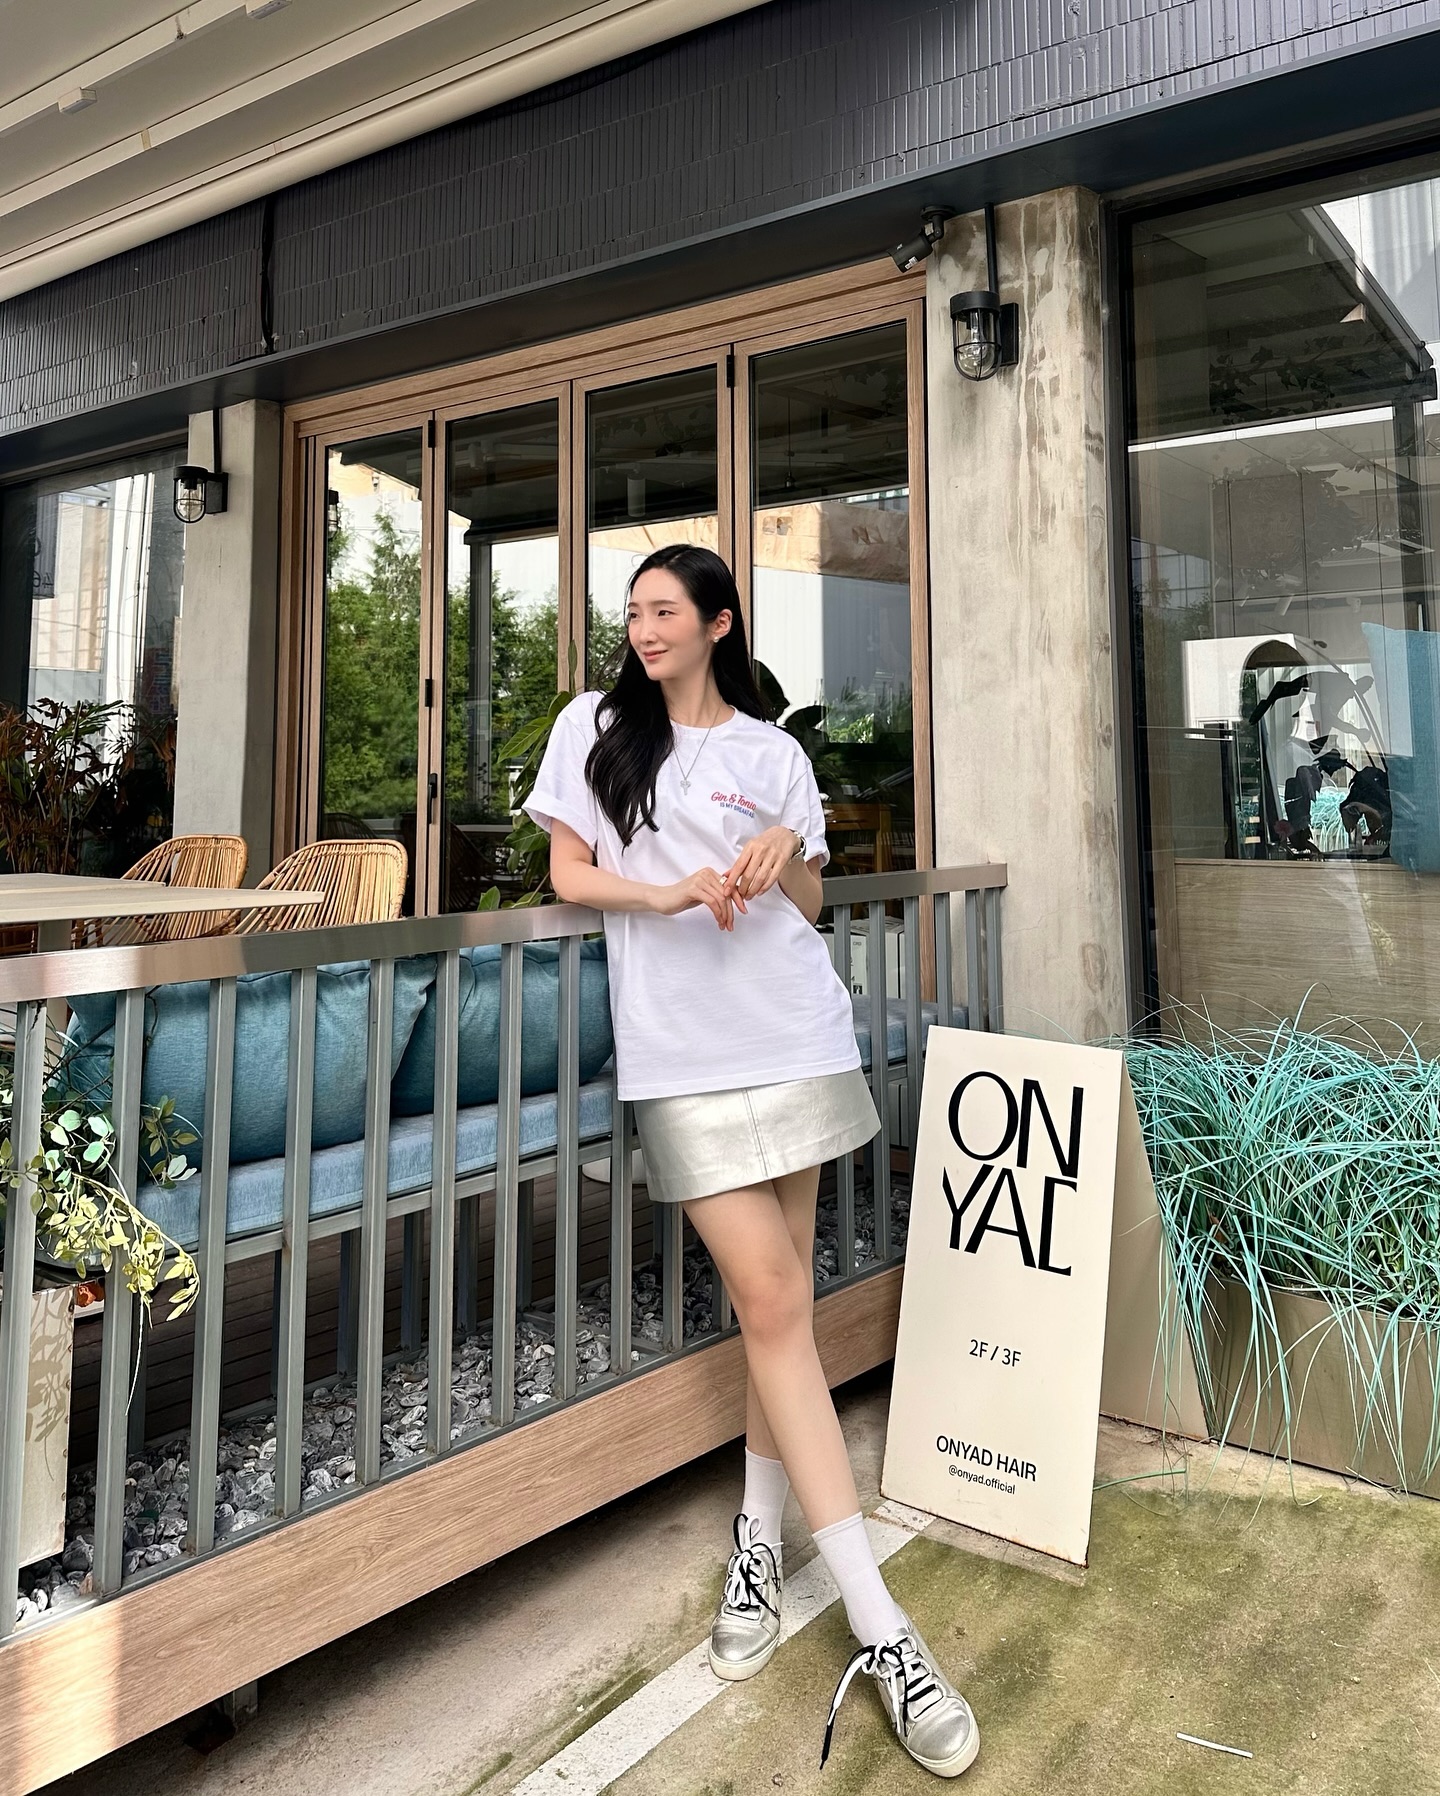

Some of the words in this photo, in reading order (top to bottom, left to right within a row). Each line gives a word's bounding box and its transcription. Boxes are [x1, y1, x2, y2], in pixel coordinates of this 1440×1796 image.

[711, 791, 728, 802] Gin
[729, 793, 738, 804] &
[738, 794, 757, 811] Tonic
[734, 804, 755, 818] BREAKFAS
[947, 1070, 1084, 1180] ON
[969, 1338, 989, 1358] 2F
[1001, 1348, 1022, 1368] 3F
[936, 1435, 993, 1467] ONYAD
[996, 1453, 1037, 1482] HAIR
[948, 1464, 1016, 1495] @onyad.official
